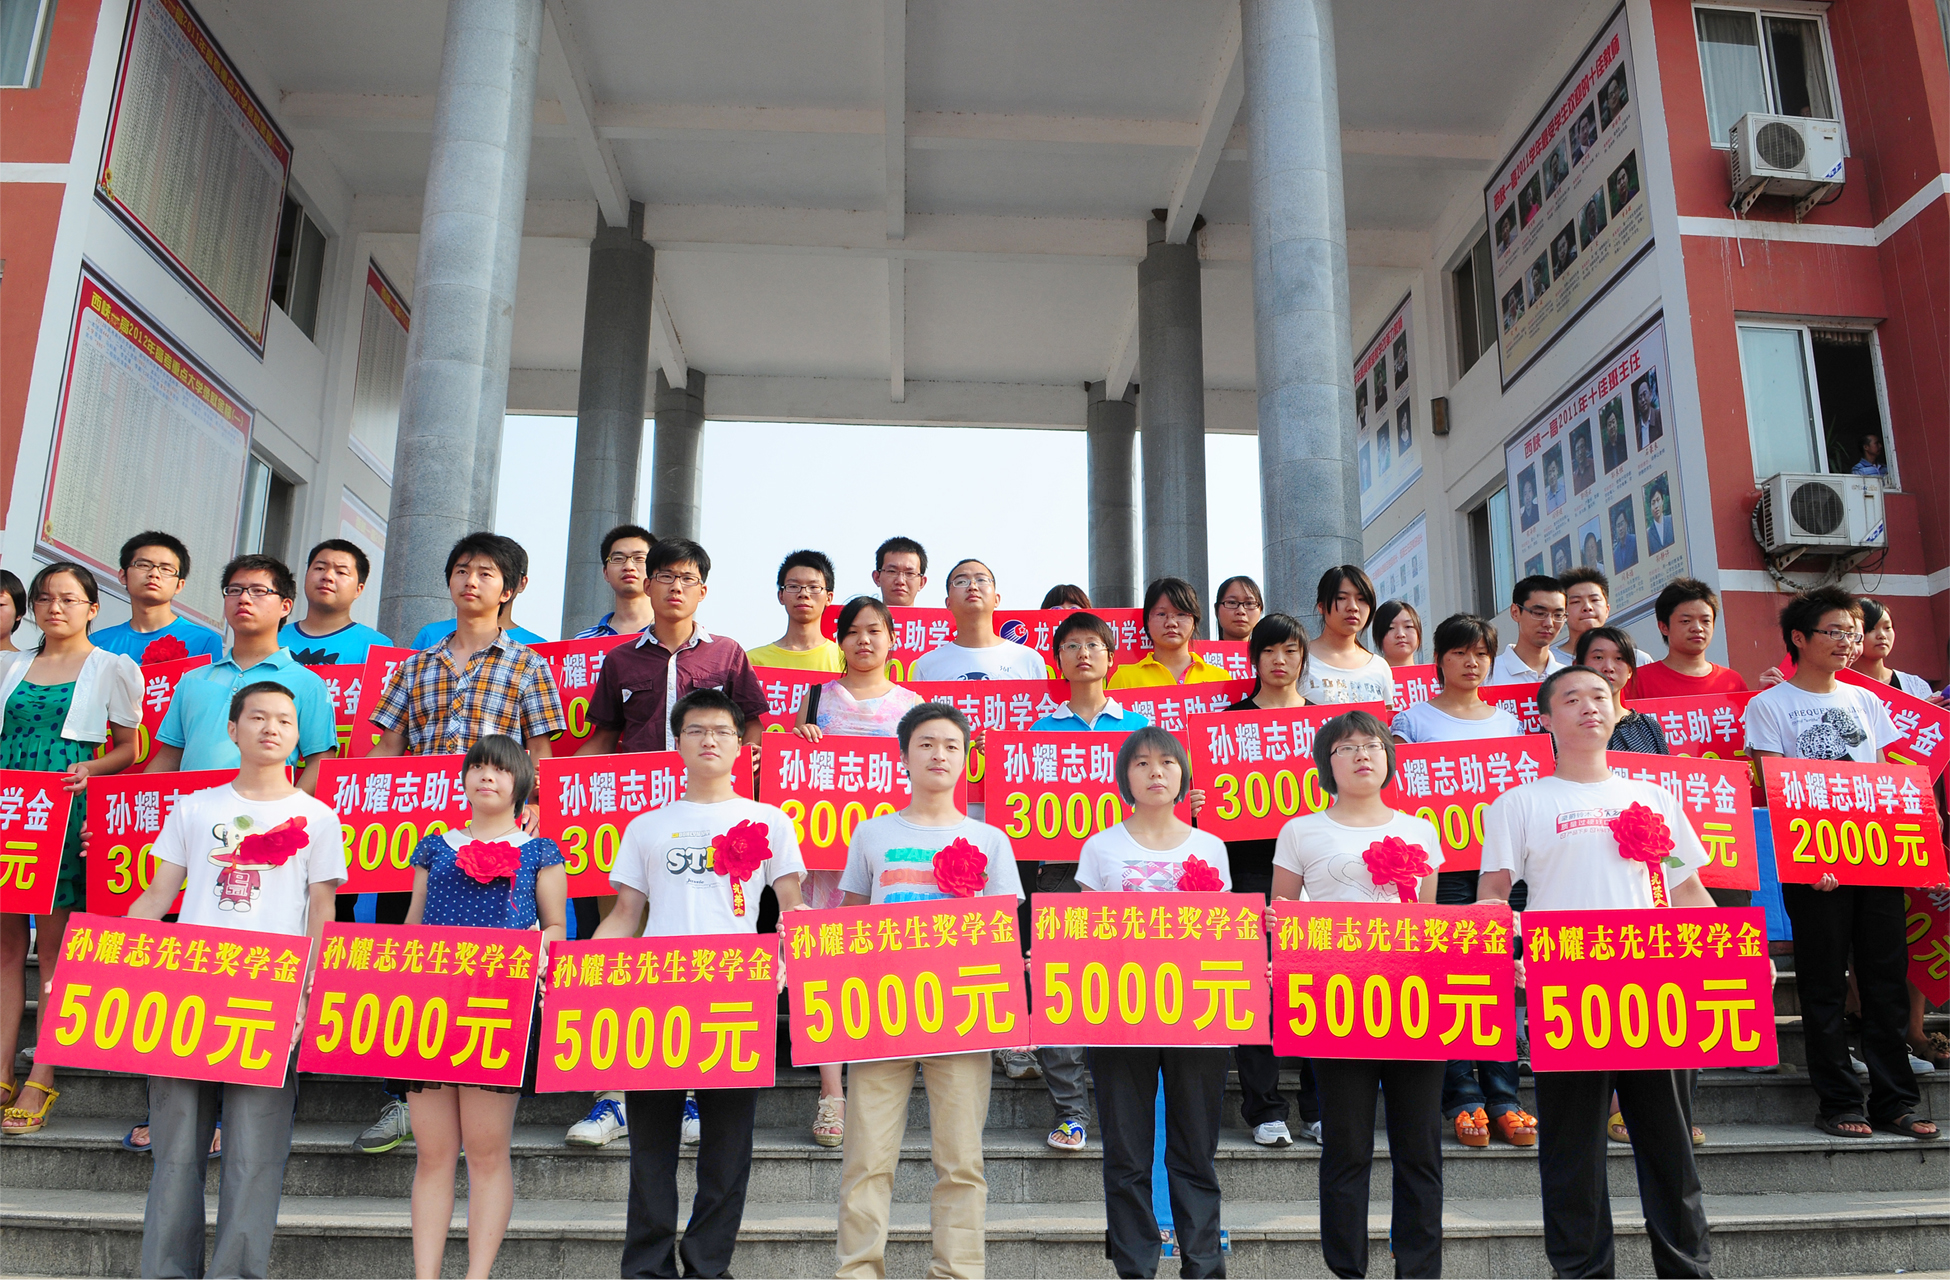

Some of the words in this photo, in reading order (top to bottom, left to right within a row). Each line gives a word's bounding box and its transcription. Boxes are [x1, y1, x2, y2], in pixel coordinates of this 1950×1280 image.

[1524, 349, 1641, 459] 西峡一高2011年十佳班主任
[1206, 716, 1333, 766] 孙耀志助
[1395, 751, 1540, 799] 耀志助学金
[1780, 770, 1923, 815] 孙耀志助学金
[1790, 817, 1929, 867] 2000元
[790, 910, 1015, 960] 孙耀志先生奖学金
[1036, 906, 1260, 941] 孙耀志先生奖学金
[1278, 917, 1508, 955] 孙耀志先生奖学金
[1529, 922, 1762, 963] 孙耀志先生奖学金
[66, 928, 301, 983] 孙耀志先生奖学金
[322, 937, 533, 980] 孙耀志先生奖学金
[553, 947, 773, 989] 孙耀志先生奖学金
[803, 964, 1016, 1043] 5000元
[1045, 960, 1254, 1031] 5000元
[1288, 974, 1501, 1047] 5000元
[1543, 979, 1761, 1053] 5000元
[55, 984, 276, 1070] 5000元
[316, 992, 512, 1070] 5000元
[554, 1002, 761, 1074] 5000元
